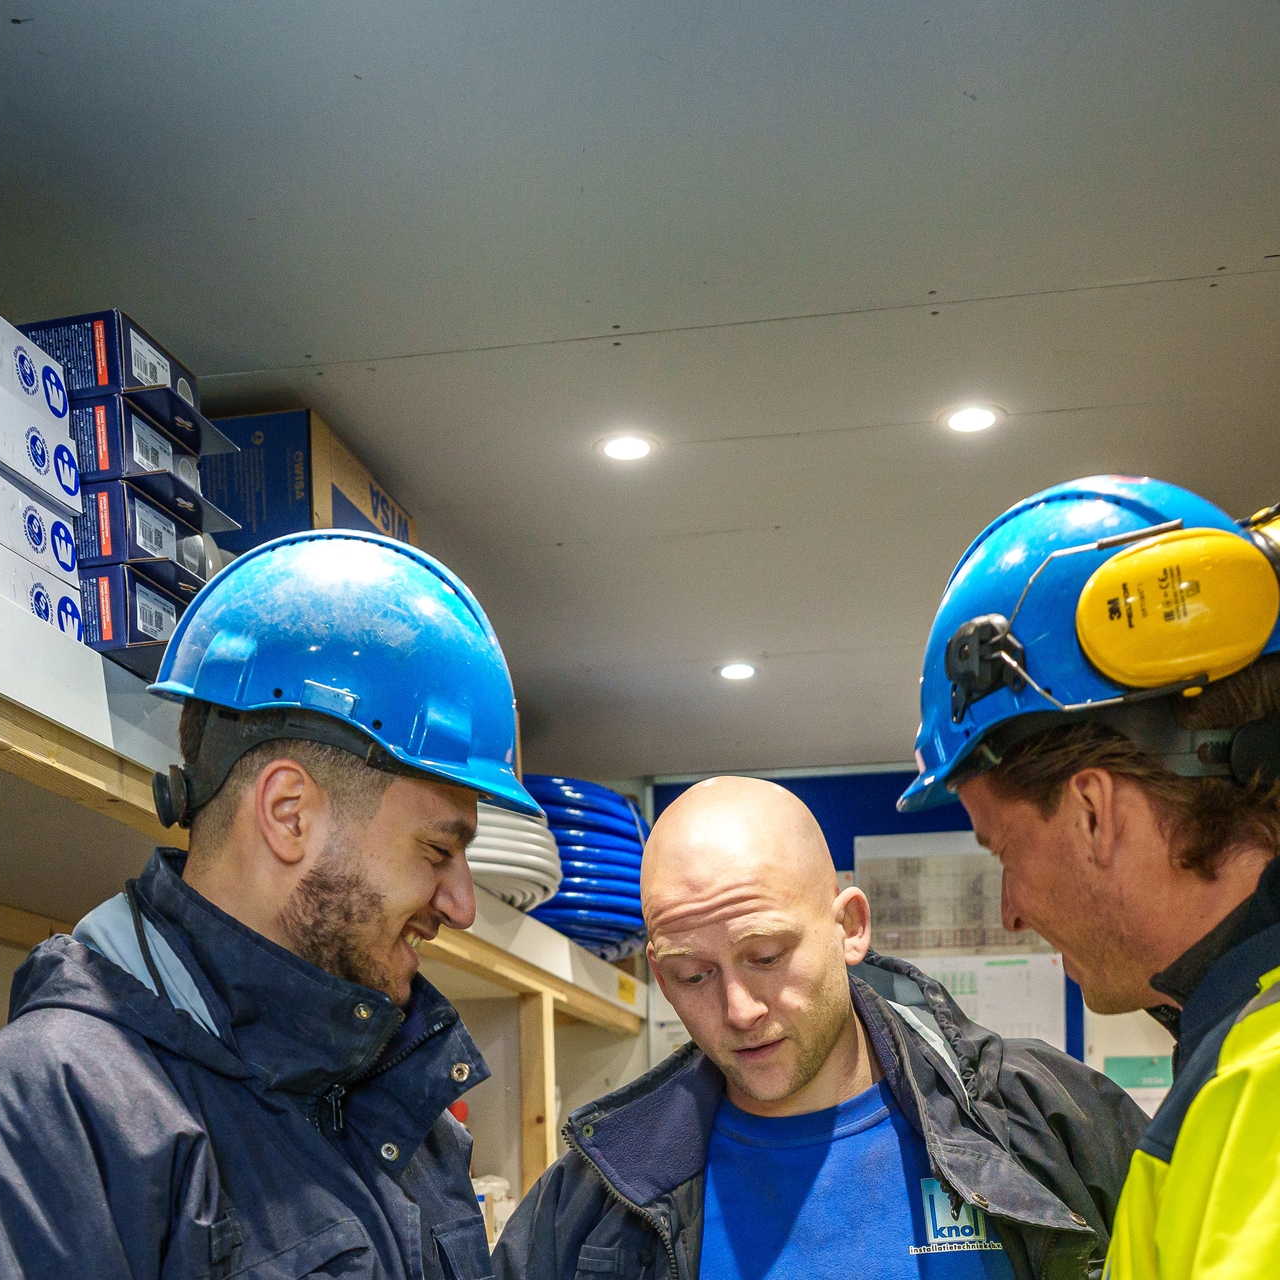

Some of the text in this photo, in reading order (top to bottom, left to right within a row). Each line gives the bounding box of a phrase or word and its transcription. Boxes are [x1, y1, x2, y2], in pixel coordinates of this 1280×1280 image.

[370, 482, 410, 543] WISA
[1107, 597, 1122, 621] 3M
[929, 1194, 980, 1239] knol
[910, 1242, 989, 1254] installatietechniek
